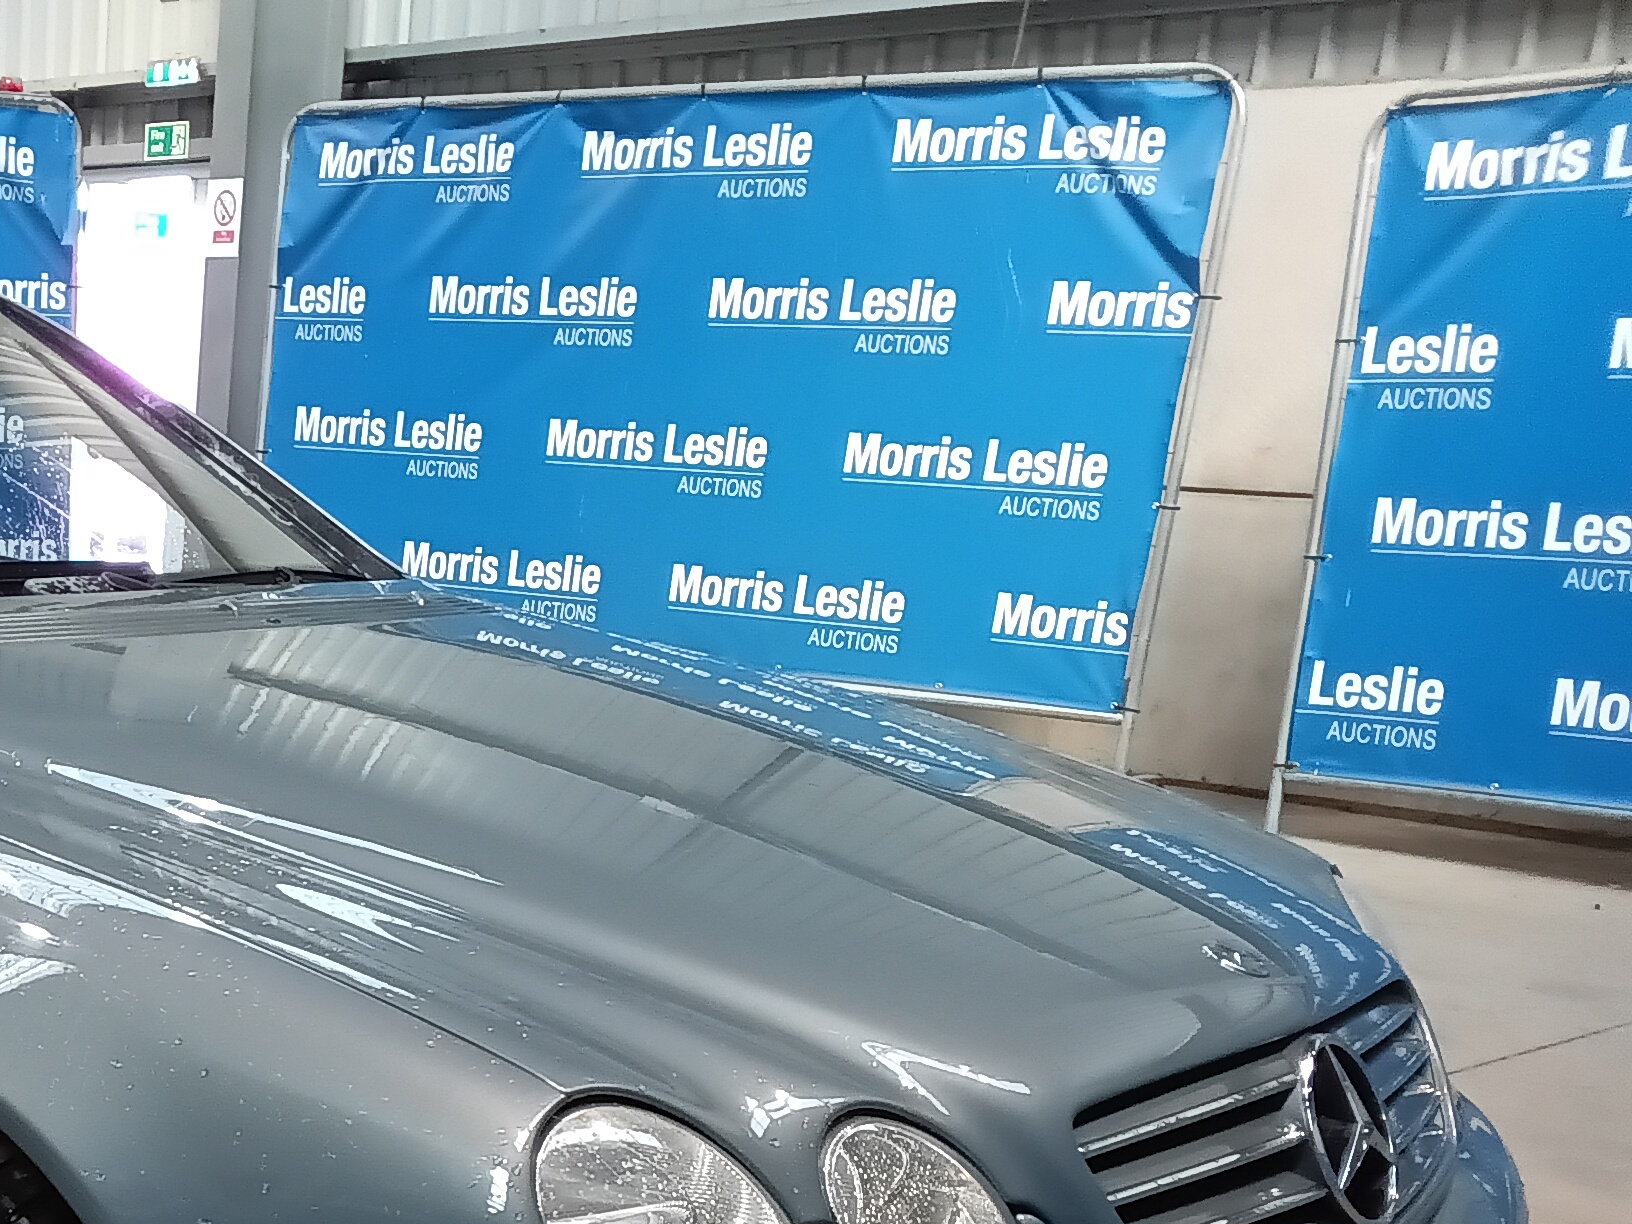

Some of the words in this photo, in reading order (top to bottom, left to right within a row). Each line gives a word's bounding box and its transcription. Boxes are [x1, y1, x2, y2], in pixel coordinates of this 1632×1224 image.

[318, 136, 415, 180] Morris
[422, 133, 515, 175] Leslie
[581, 125, 692, 172] Morris
[702, 122, 814, 168] Leslie
[891, 114, 1028, 164] Morris
[1038, 113, 1167, 164] Leslie
[1423, 129, 1593, 192] Morris
[435, 183, 511, 204] AUCTIONS
[716, 176, 808, 200] AUCTIONS
[1055, 172, 1158, 197] AUCTIONS
[282, 276, 367, 316] Leslie
[428, 275, 530, 317] Morris
[538, 276, 638, 319] Leslie
[707, 276, 829, 321] Morris
[839, 277, 957, 323] Leslie
[1046, 279, 1195, 329] Morris
[294, 323, 364, 343] AUCTIONS
[552, 327, 634, 348] AUCTIONS
[853, 333, 950, 356] AUCTIONS
[1360, 322, 1500, 376] Leslie
[1376, 386, 1494, 411] AUCTIONS
[293, 405, 387, 450] Morris
[393, 410, 483, 453] Leslie
[545, 418, 654, 463] Morris
[663, 423, 769, 469] Leslie
[405, 459, 479, 480] AUCTIONS
[842, 431, 973, 481] Morris
[983, 438, 1109, 489] Leslie
[676, 475, 763, 499] AUCTIONS
[998, 495, 1101, 522] AUCTIONS
[1370, 496, 1530, 551] Morris
[1542, 501, 1632, 556] Les
[401, 540, 499, 585] Morris
[506, 549, 602, 595] Leslie
[1562, 566, 1632, 593] AUCT
[668, 563, 785, 613] Morris
[793, 574, 907, 624] Leslie
[806, 627, 900, 655] AUCTIONS
[992, 591, 1130, 647] Morris
[1307, 659, 1446, 716] Leslie
[1325, 720, 1438, 751] AUCTIONS
